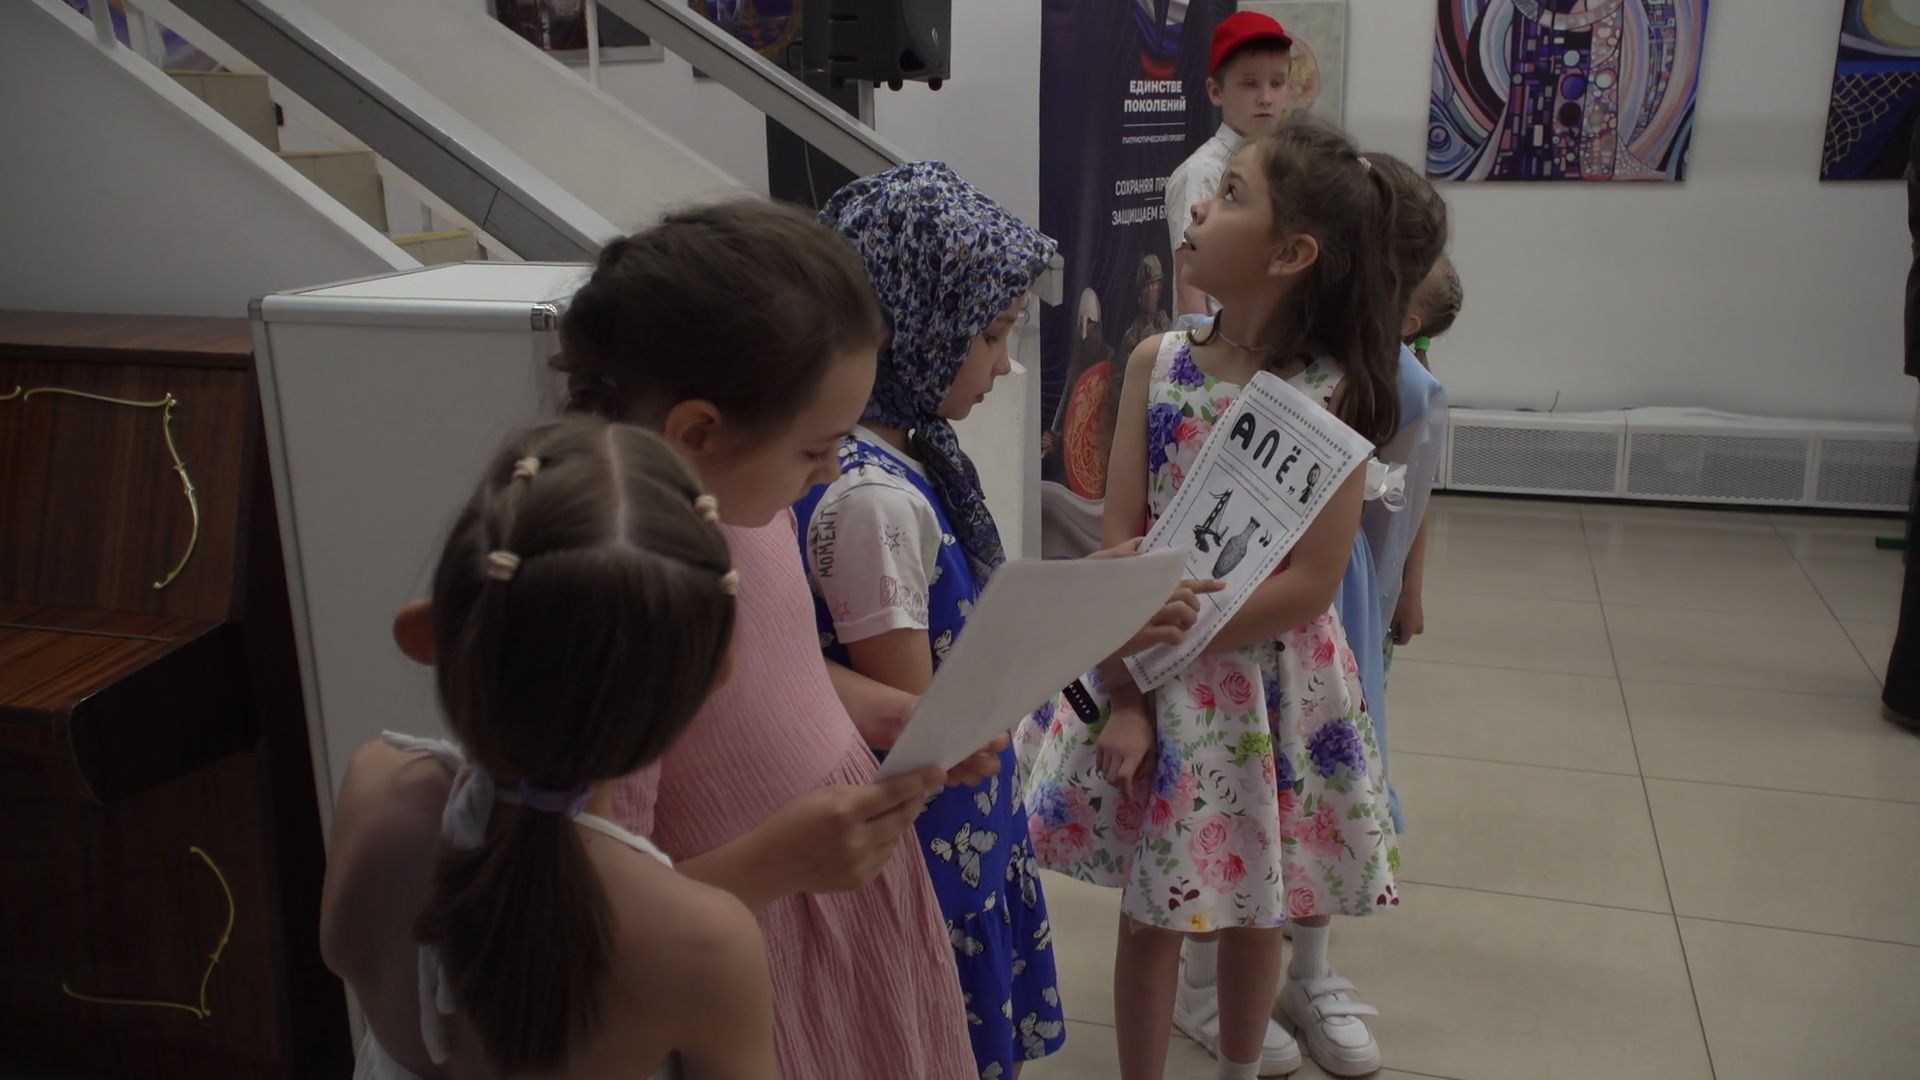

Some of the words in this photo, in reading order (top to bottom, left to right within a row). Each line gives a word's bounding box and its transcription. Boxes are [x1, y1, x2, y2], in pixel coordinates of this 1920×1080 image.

[1129, 80, 1183, 95] ЕДИНСТВЕ
[1124, 96, 1186, 113] ПОКОЛЕНИЙ
[1115, 178, 1154, 196] СОХРАНЯЯ
[1111, 206, 1158, 226] ЗАЩИЩАЕМ
[818, 511, 837, 578] MOMENT
